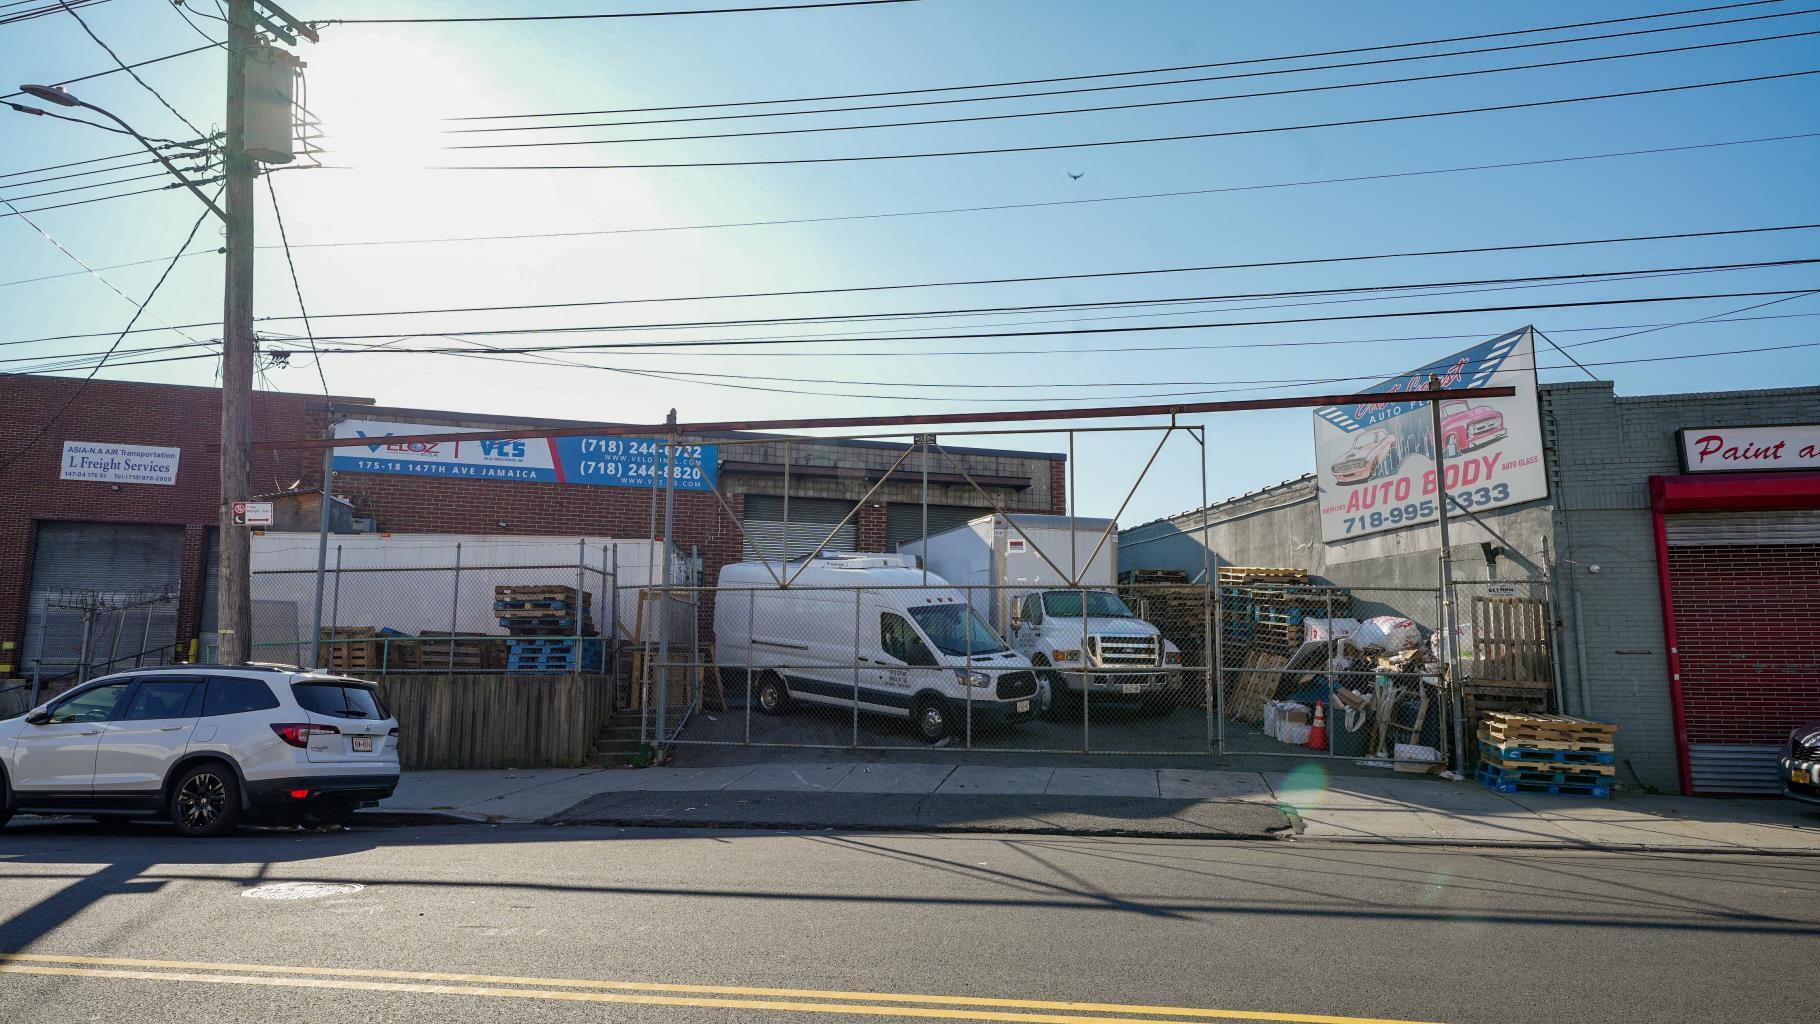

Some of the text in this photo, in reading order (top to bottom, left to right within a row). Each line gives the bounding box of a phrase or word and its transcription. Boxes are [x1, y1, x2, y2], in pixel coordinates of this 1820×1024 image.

[1369, 407, 1401, 424] AUTO
[105, 448, 119, 456] AIR
[121, 449, 176, 459] Transportation
[480, 439, 525, 457] VCS
[581, 438, 624, 455] (718)
[1695, 435, 1820, 463] Paint a
[69, 456, 170, 473] L Freight Services
[358, 460, 537, 478] 175-18 147TH AVE JAMAICA
[580, 460, 623, 478] (718)
[1502, 456, 1539, 471] AUTO GLASS
[1346, 452, 1503, 514] AUTO BODY
